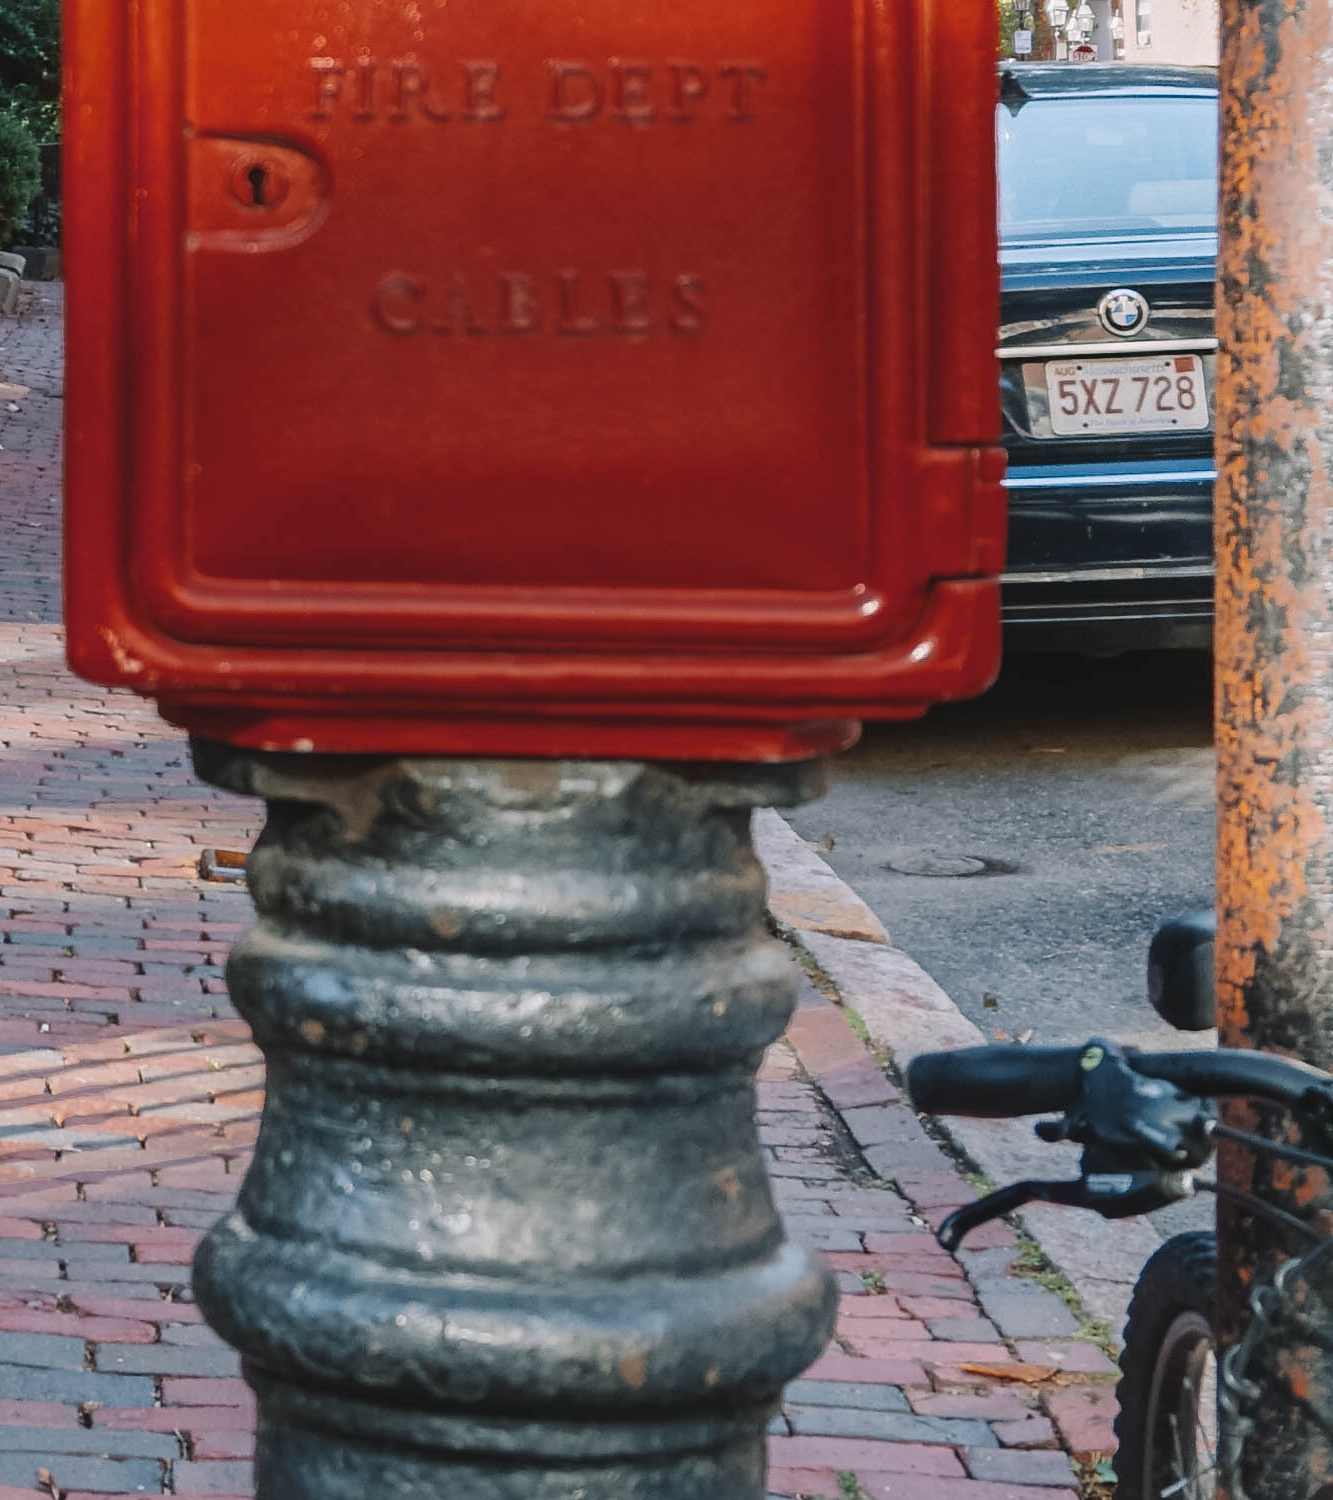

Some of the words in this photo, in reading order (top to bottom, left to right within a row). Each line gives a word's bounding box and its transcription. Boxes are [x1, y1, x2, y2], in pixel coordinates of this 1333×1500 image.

[305, 57, 507, 123] FIRE
[543, 57, 769, 125] DEPT
[369, 267, 710, 339] CABLES
[1058, 378, 1124, 416] 5XZ
[1131, 375, 1196, 413] 728
